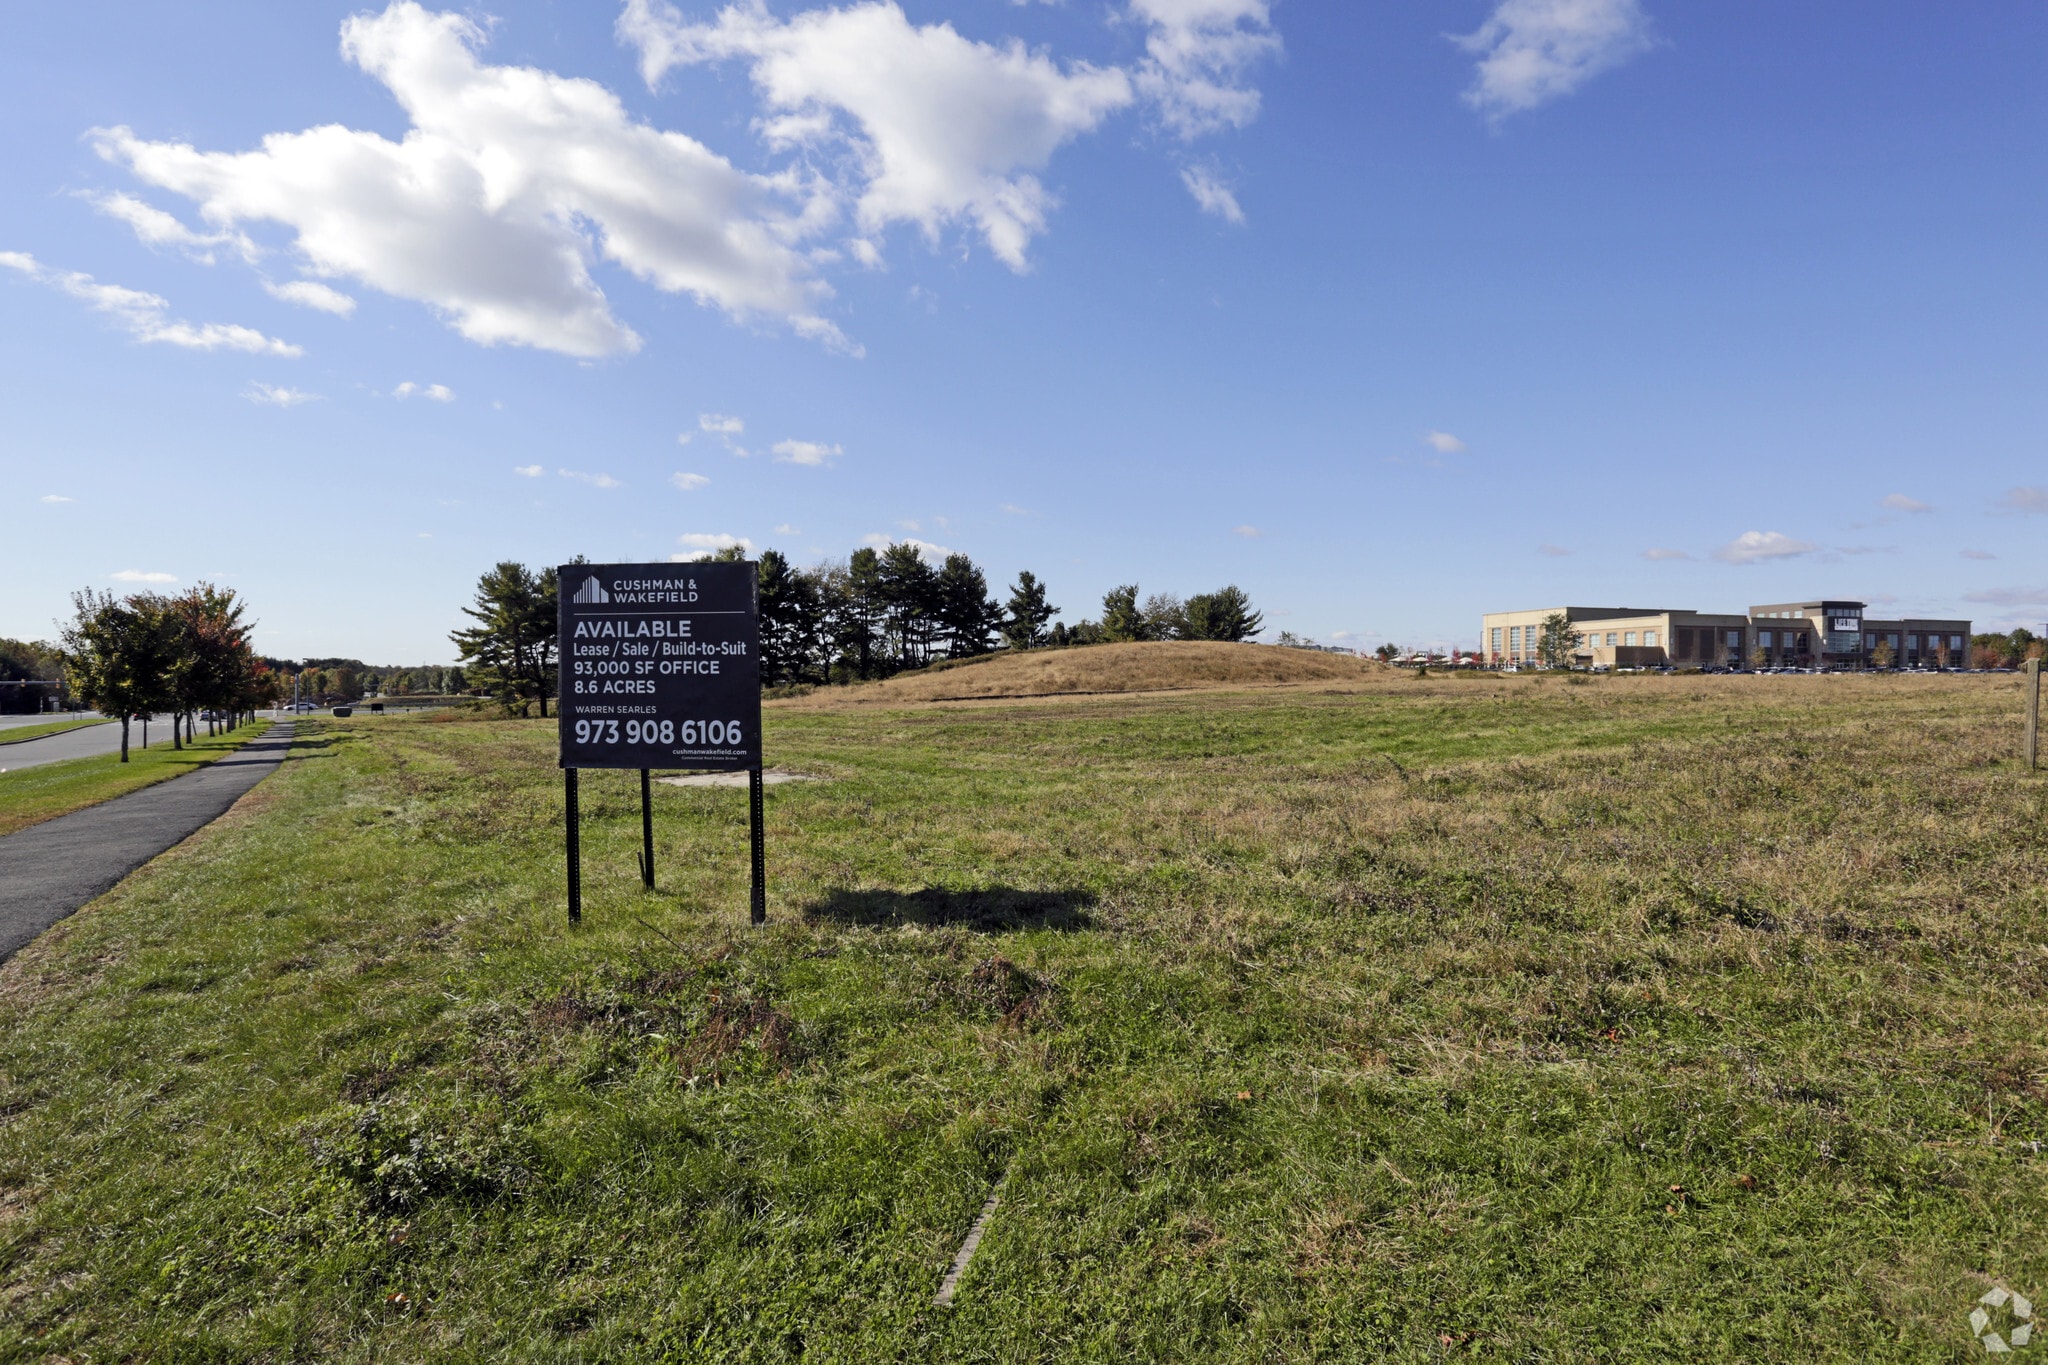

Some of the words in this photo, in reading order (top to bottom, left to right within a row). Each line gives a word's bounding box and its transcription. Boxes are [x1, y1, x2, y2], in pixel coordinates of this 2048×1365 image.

[614, 579, 684, 591] CUSHMAN
[688, 579, 697, 589] &
[614, 592, 698, 603] WAKEFIELD
[574, 620, 692, 638] AVAILABLE
[574, 642, 609, 656] Lease
[622, 642, 649, 656] Sale
[663, 641, 746, 655] Build-to-Suit
[575, 661, 629, 677] 93,000
[635, 661, 654, 674] SF
[660, 660, 720, 674] OFFICE
[575, 681, 598, 694] 8.6
[603, 680, 655, 693] ACRES
[575, 720, 619, 744] 973
[626, 720, 674, 744] 908
[682, 720, 742, 744] 6106
